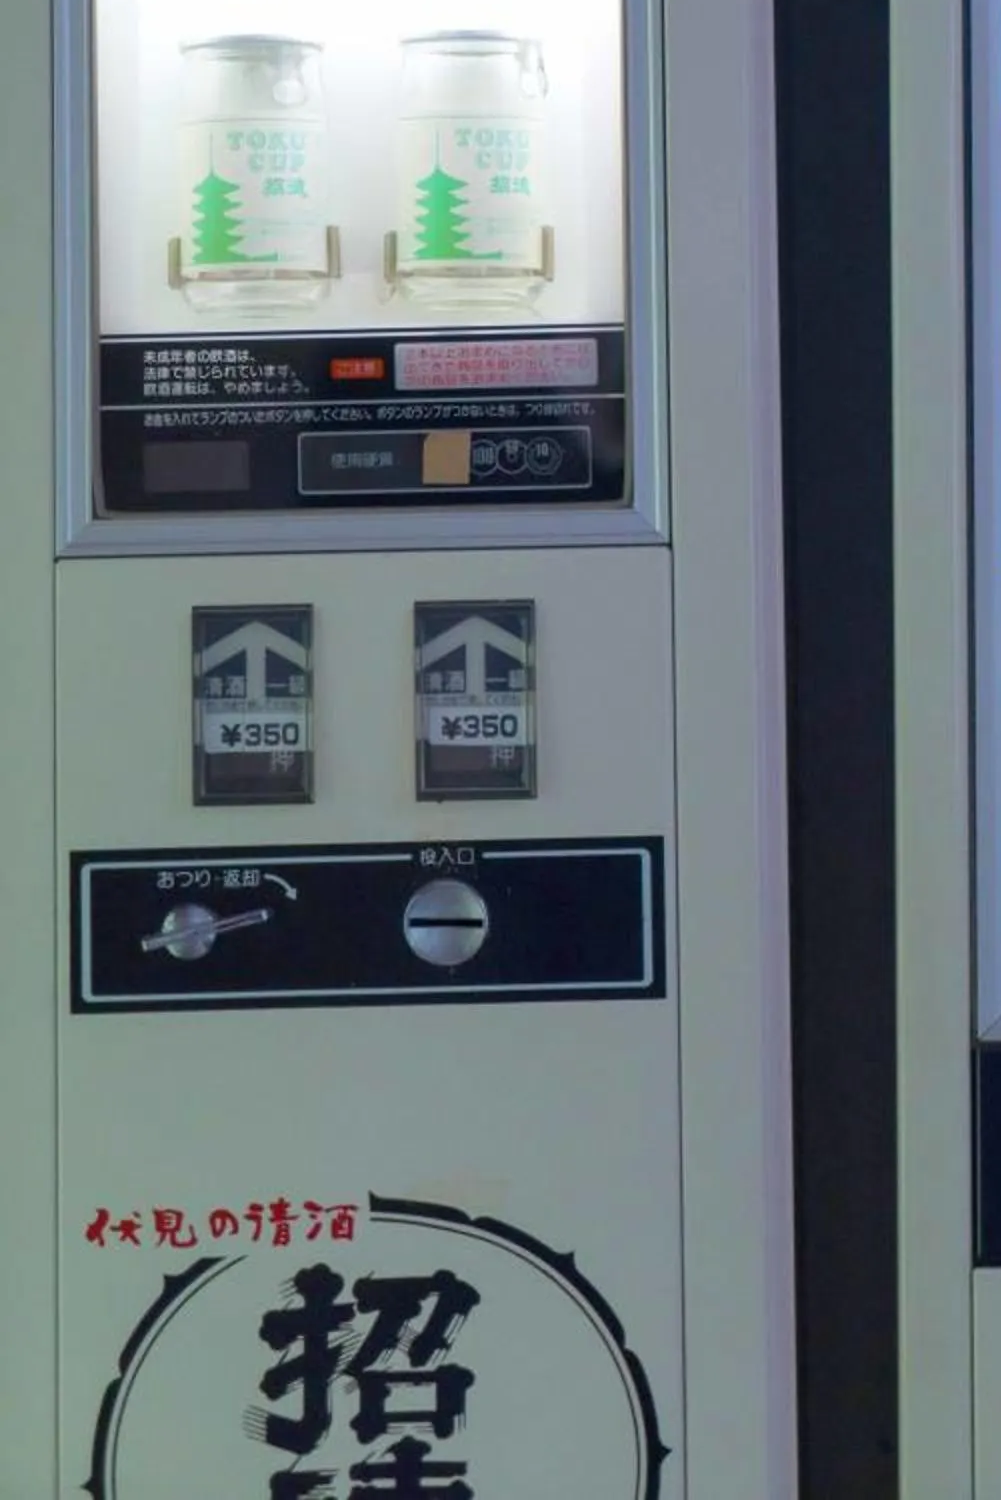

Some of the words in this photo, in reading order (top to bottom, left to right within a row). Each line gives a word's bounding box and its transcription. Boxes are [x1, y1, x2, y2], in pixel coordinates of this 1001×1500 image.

[221, 722, 299, 747] ¥350
[441, 714, 518, 740] ¥350
[420, 847, 475, 866] 投入口
[85, 1198, 359, 1249] 伏見の清酒
